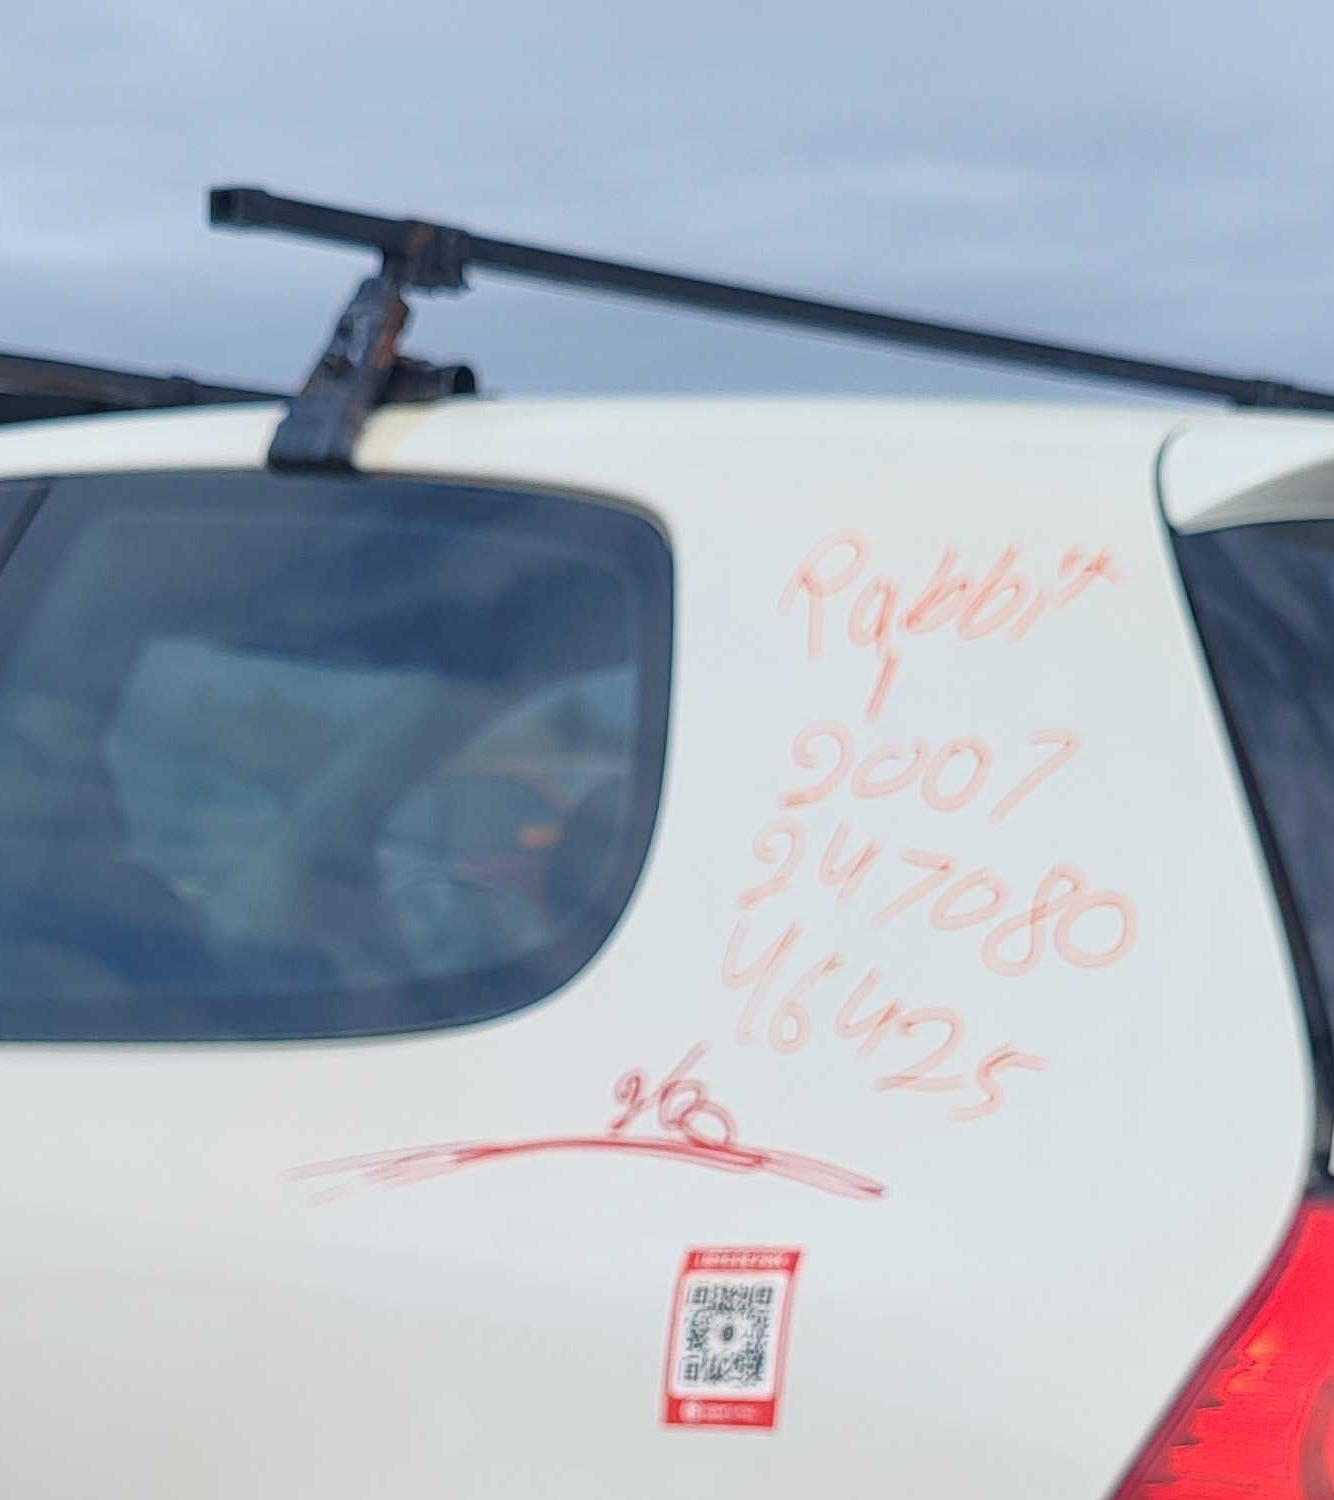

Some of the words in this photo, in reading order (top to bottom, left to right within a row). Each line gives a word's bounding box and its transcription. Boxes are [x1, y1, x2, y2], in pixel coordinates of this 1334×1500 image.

[777, 720, 1082, 823] 2007
[737, 818, 1137, 978] 247080
[719, 915, 1052, 1124] 46425
